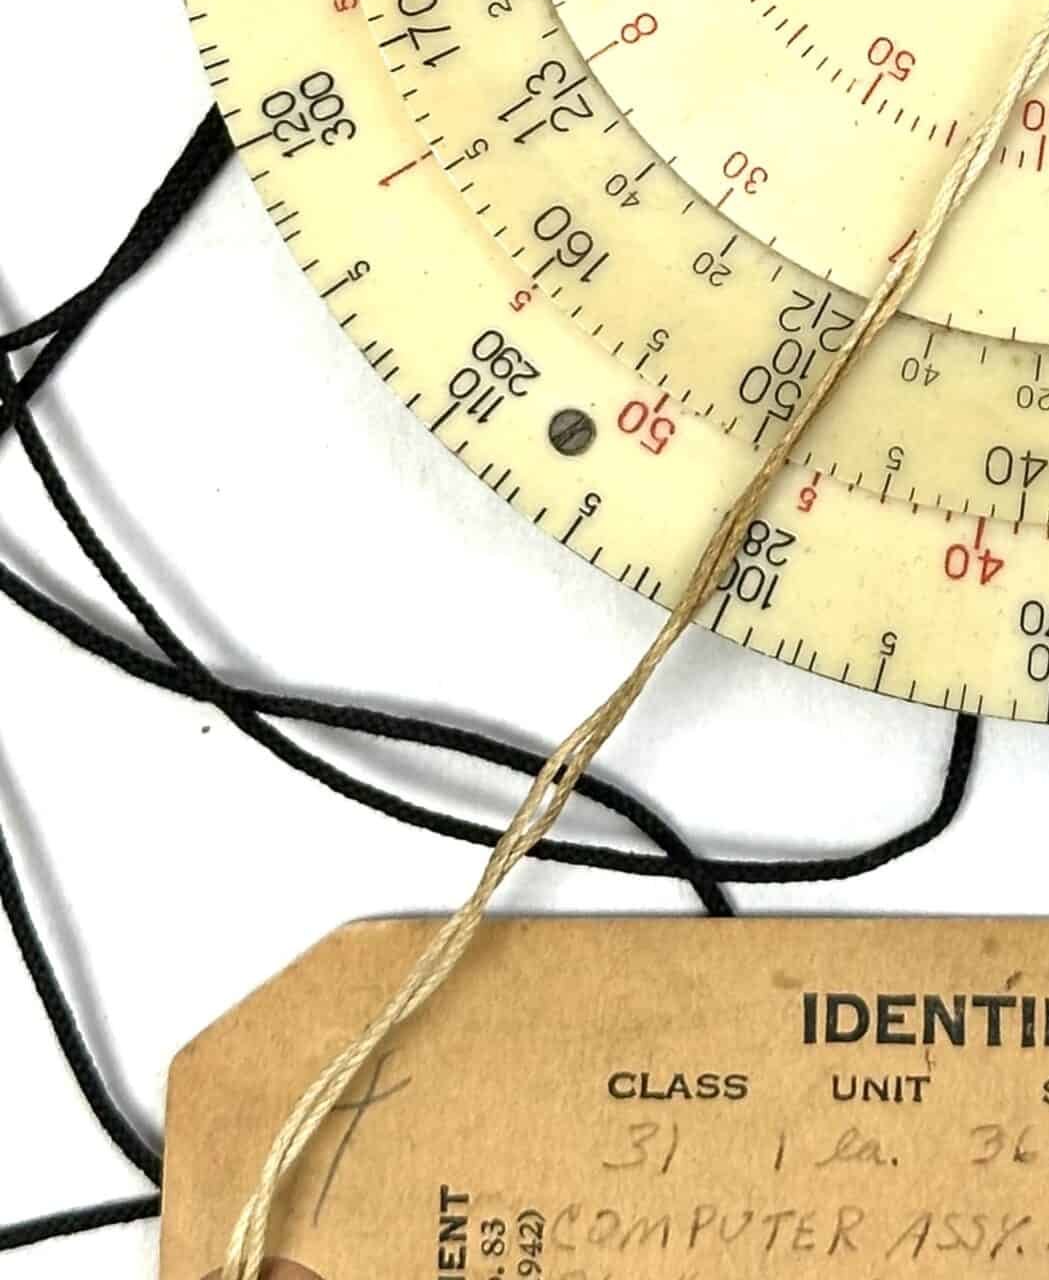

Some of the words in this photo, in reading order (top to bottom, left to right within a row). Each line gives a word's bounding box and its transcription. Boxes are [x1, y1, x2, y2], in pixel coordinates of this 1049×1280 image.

[621, 13, 658, 44] 8
[868, 38, 916, 81] 50
[262, 91, 315, 158] 120
[300, 71, 356, 146] 300
[465, 139, 489, 159] 5
[534, 206, 609, 283] 160
[472, 330, 541, 397] 290
[901, 357, 939, 386] 40
[449, 368, 504, 423] 110
[617, 401, 675, 455] 50
[579, 492, 601, 517] 5
[945, 544, 1004, 584] 40
[607, 1071, 749, 1101] CLASS
[832, 1076, 931, 1103] UNIT
[602, 1123, 680, 1174] 31
[438, 1184, 470, 1280] ENT
[480, 1218, 507, 1255] 83
[516, 1208, 546, 1280] 942)
[550, 1203, 866, 1257] COMPUTER
